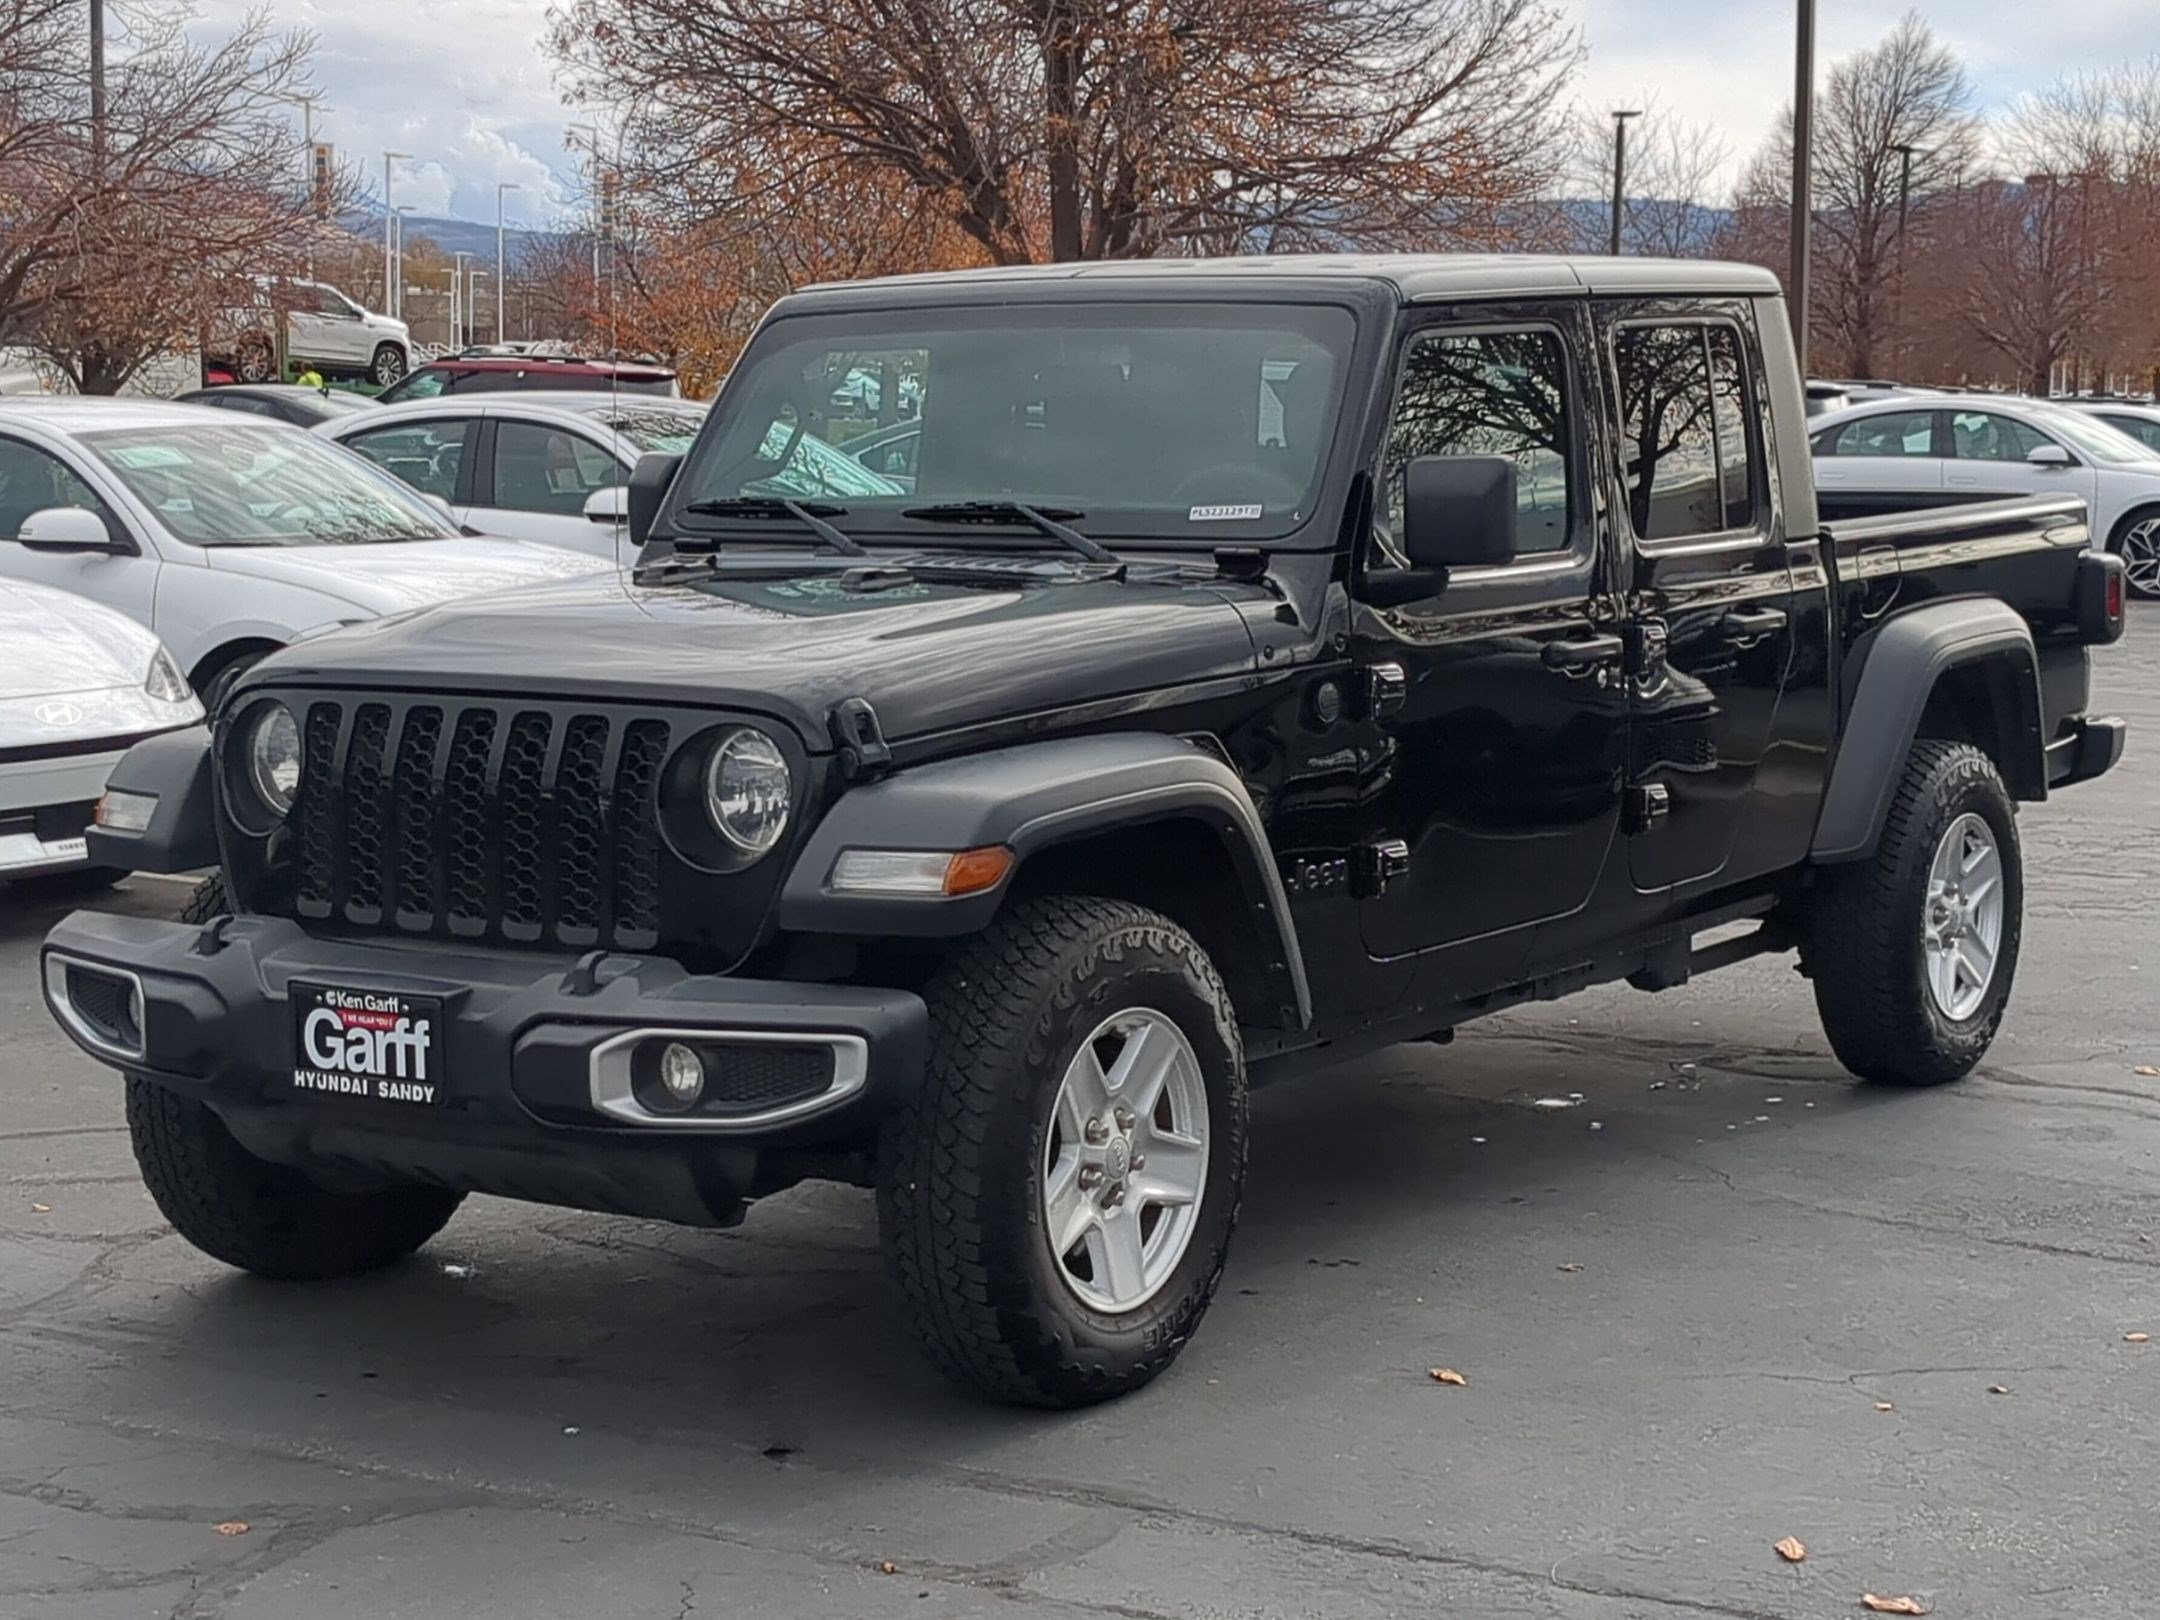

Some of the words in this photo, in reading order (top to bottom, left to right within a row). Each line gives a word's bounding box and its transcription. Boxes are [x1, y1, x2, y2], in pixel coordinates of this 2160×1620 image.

[337, 991, 363, 1010] Ken
[365, 994, 399, 1013] Garff
[303, 1007, 430, 1080] Garff
[294, 1070, 368, 1095] HYUNDAI
[378, 1081, 435, 1103] SANDY
